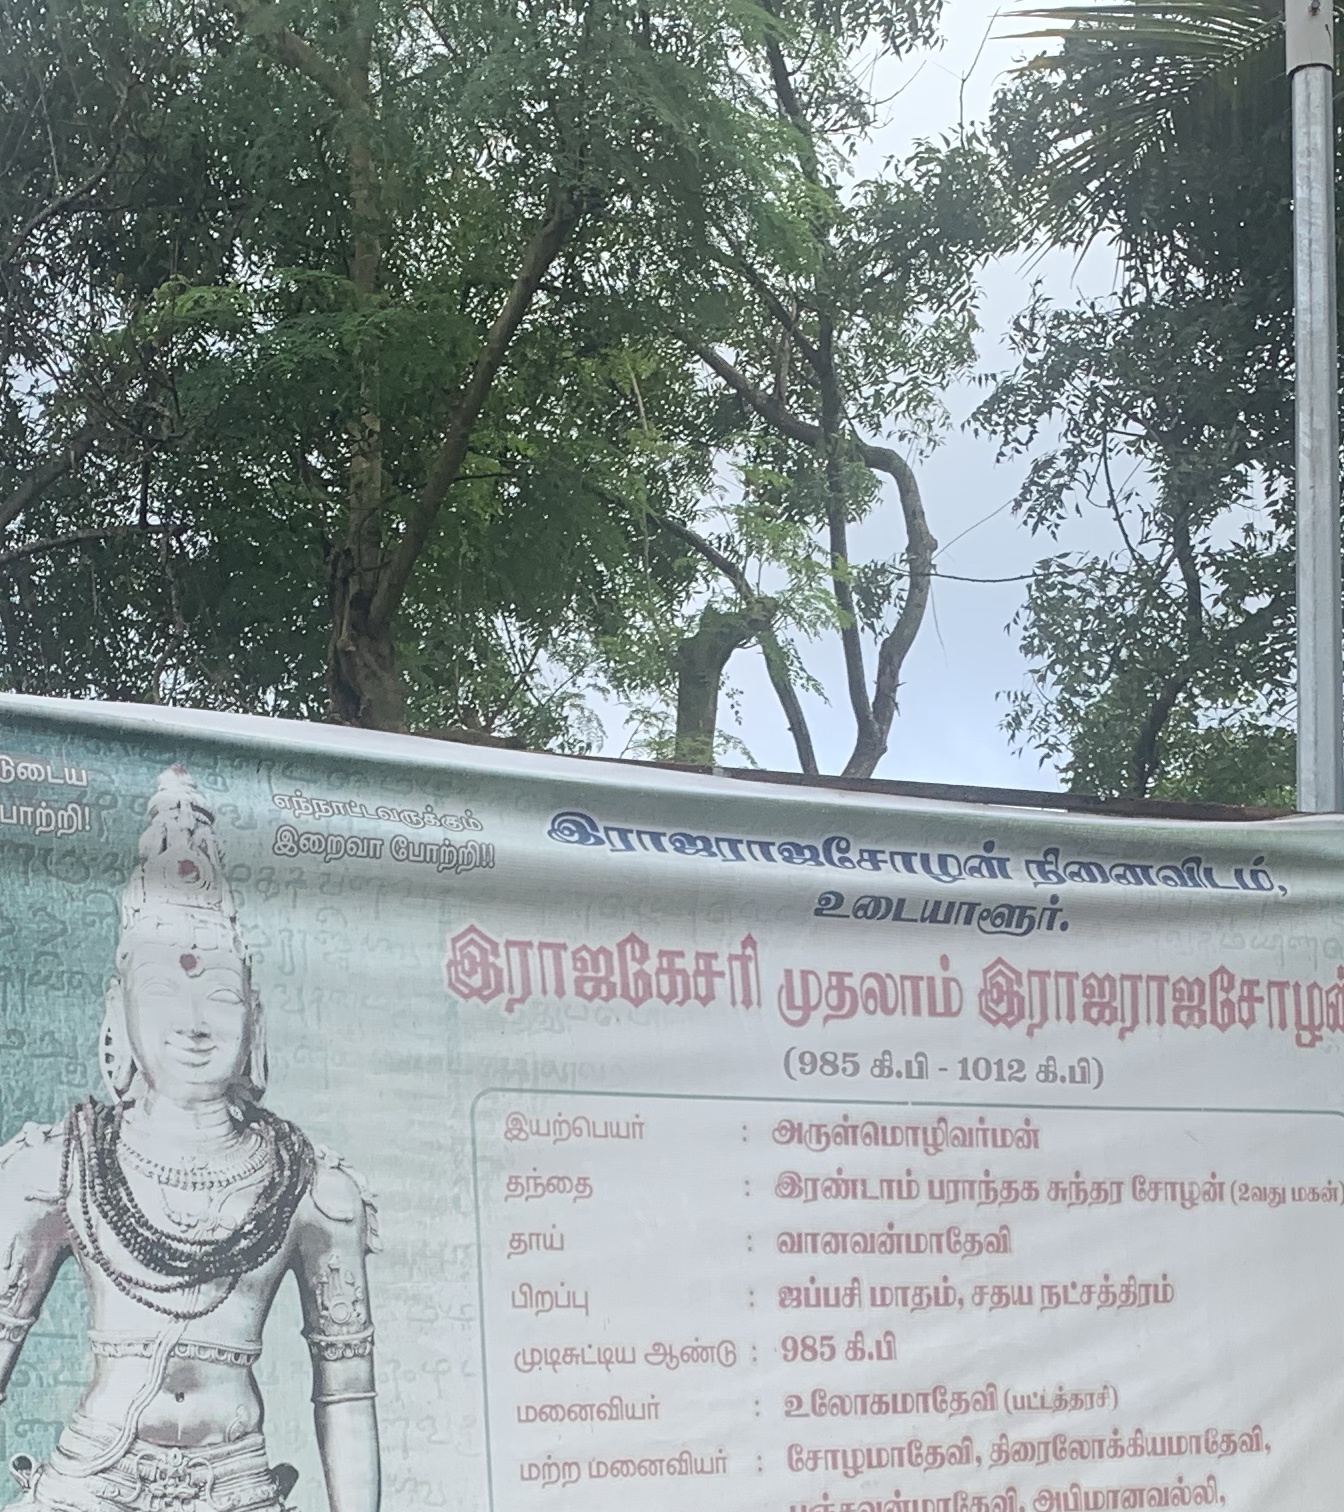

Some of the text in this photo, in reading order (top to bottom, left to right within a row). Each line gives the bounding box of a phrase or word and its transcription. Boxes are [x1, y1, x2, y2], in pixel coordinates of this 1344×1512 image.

[272, 789, 484, 833] எந்நாட்டவருக்கும்
[272, 824, 385, 863] இறைவா
[546, 809, 1288, 897] இராஜராஜசோழன் நினைவிடம்,
[814, 887, 1070, 934] உடையாளூர்.
[447, 922, 759, 1014] இராஜகேசரி
[777, 953, 964, 1027] முதலாம்
[783, 1047, 860, 1082] (985
[869, 1047, 930, 1082] கி.பி
[957, 1056, 1027, 1085] 1012
[1035, 1056, 1105, 1091] கி.பி)
[504, 1111, 645, 1146] இயற்பெயர்
[771, 1113, 1041, 1157] அருள்மொழிவர்மன்
[504, 1167, 593, 1201] தந்தை
[773, 1166, 920, 1204] இரண்டாம்
[927, 1170, 1040, 1208] பராந்தக
[1047, 1170, 1124, 1208] சுந்தர
[1131, 1171, 1226, 1210] சோழன்
[507, 1224, 565, 1259] தாய்
[776, 1220, 1013, 1260] வானவன்மாதேவி
[511, 1281, 590, 1316] பிறப்பு
[869, 1276, 965, 1313] மாதம்,
[971, 1281, 1034, 1312] சதய
[1039, 1273, 1175, 1313] நட்சத்திரம்
[644, 1336, 737, 1372] ஆண்டு
[781, 1334, 837, 1363] 985
[844, 1331, 898, 1363] கி.பி
[516, 1394, 661, 1424] மனைவியர்
[784, 1383, 1000, 1418] உலோகமாதேவி
[520, 1454, 582, 1489] மற்ற
[588, 1448, 728, 1479] மனைவியர்
[787, 1436, 983, 1479] சோழமாதேவி,
